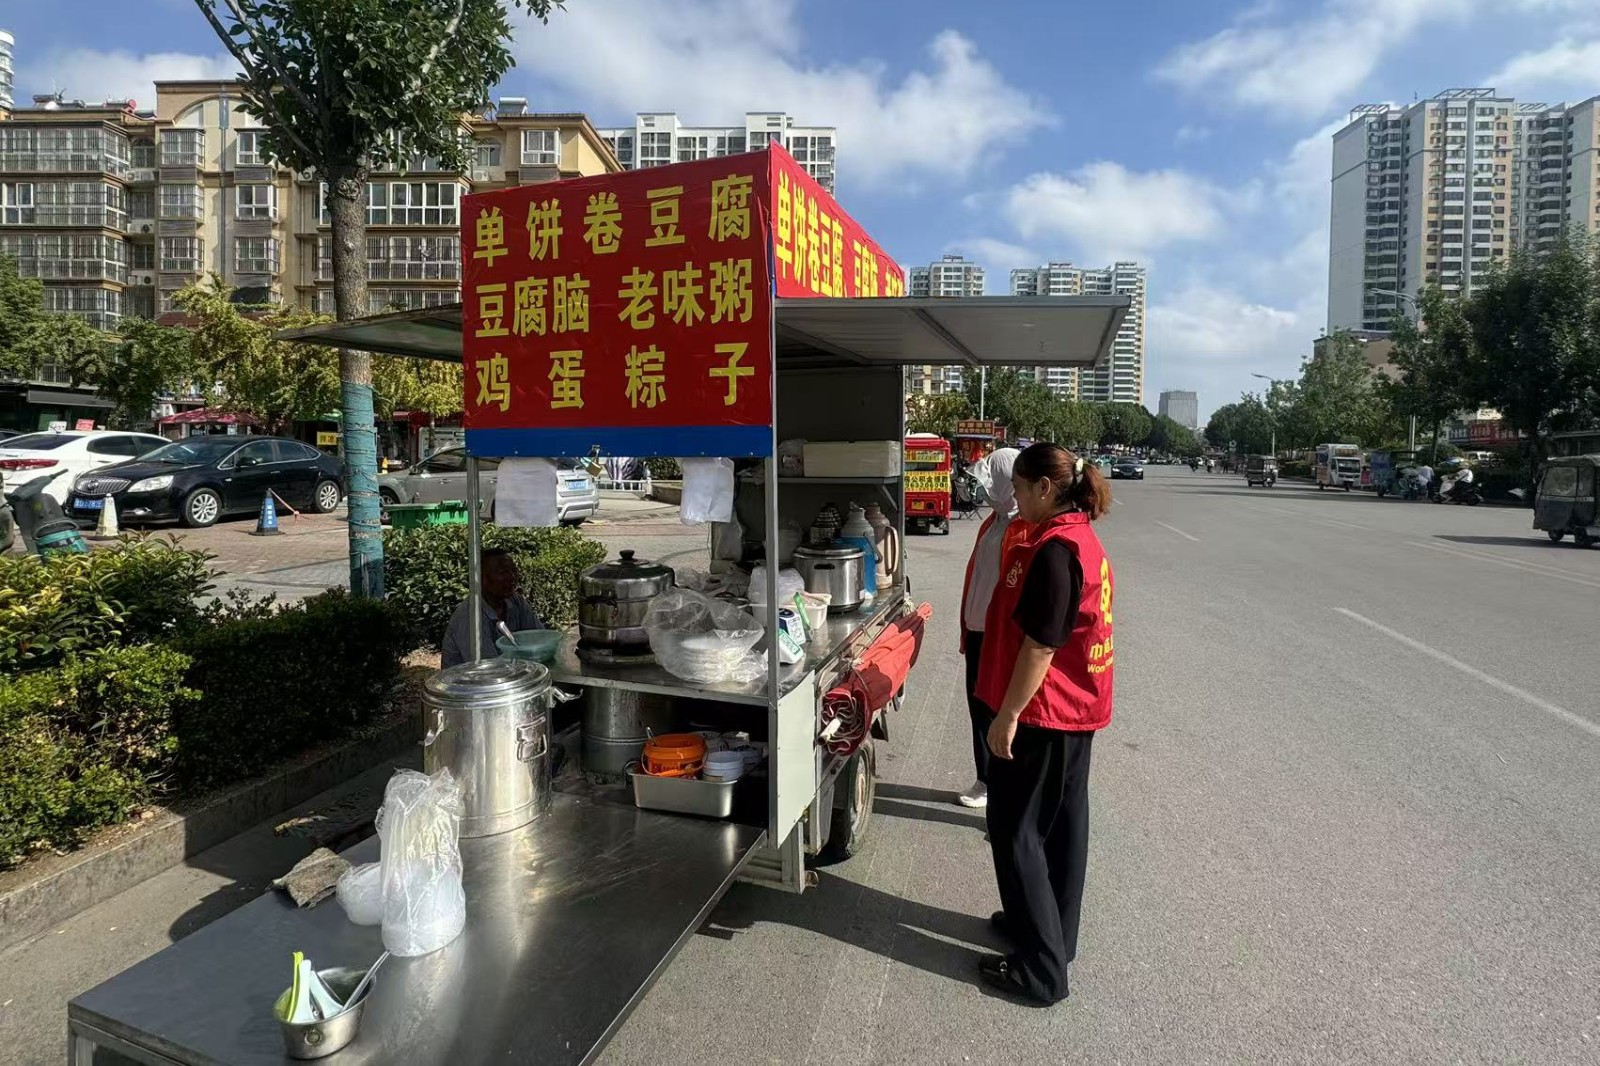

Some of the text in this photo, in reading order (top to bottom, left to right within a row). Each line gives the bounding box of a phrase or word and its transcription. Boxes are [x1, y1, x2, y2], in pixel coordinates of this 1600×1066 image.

[473, 173, 754, 267] 单饼卷豆腐
[474, 258, 753, 338] 豆腐脑 老味粥
